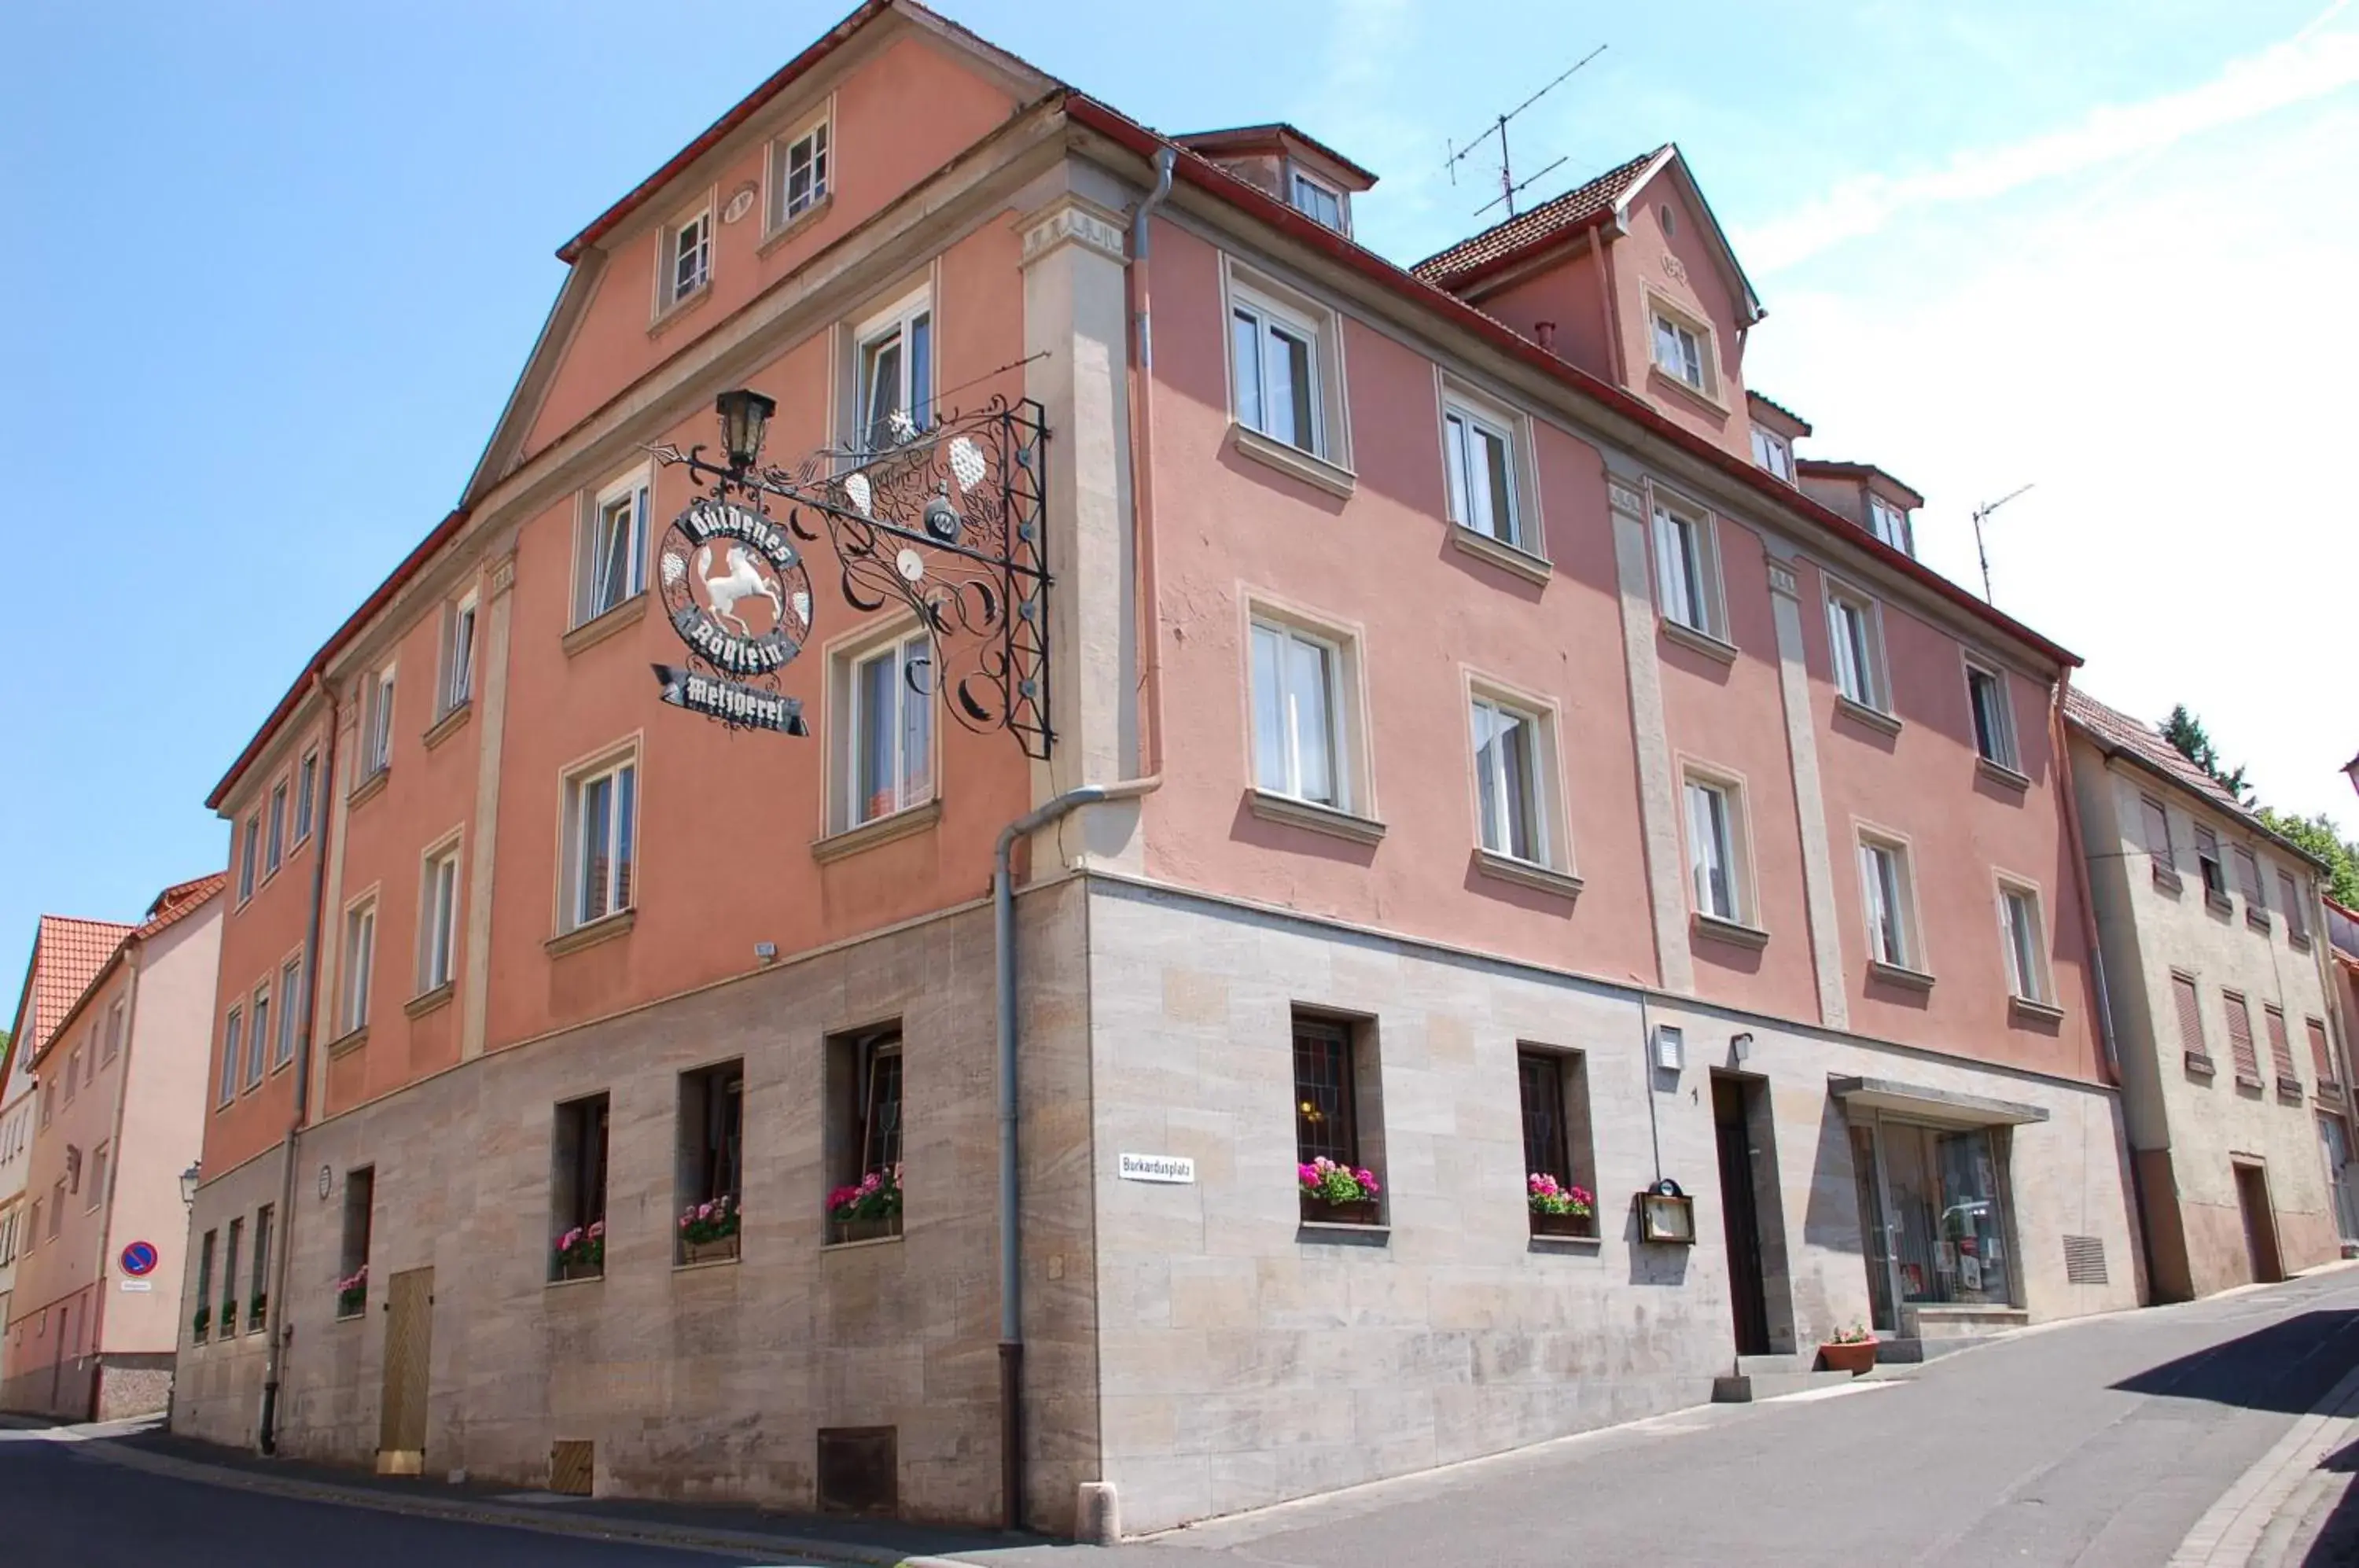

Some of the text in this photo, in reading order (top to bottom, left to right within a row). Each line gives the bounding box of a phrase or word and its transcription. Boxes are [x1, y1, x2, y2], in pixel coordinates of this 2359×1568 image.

[690, 506, 792, 561] Güldenes
[687, 675, 785, 722] Metzgerei
[1123, 1156, 1190, 1178] Burkardusplatz
